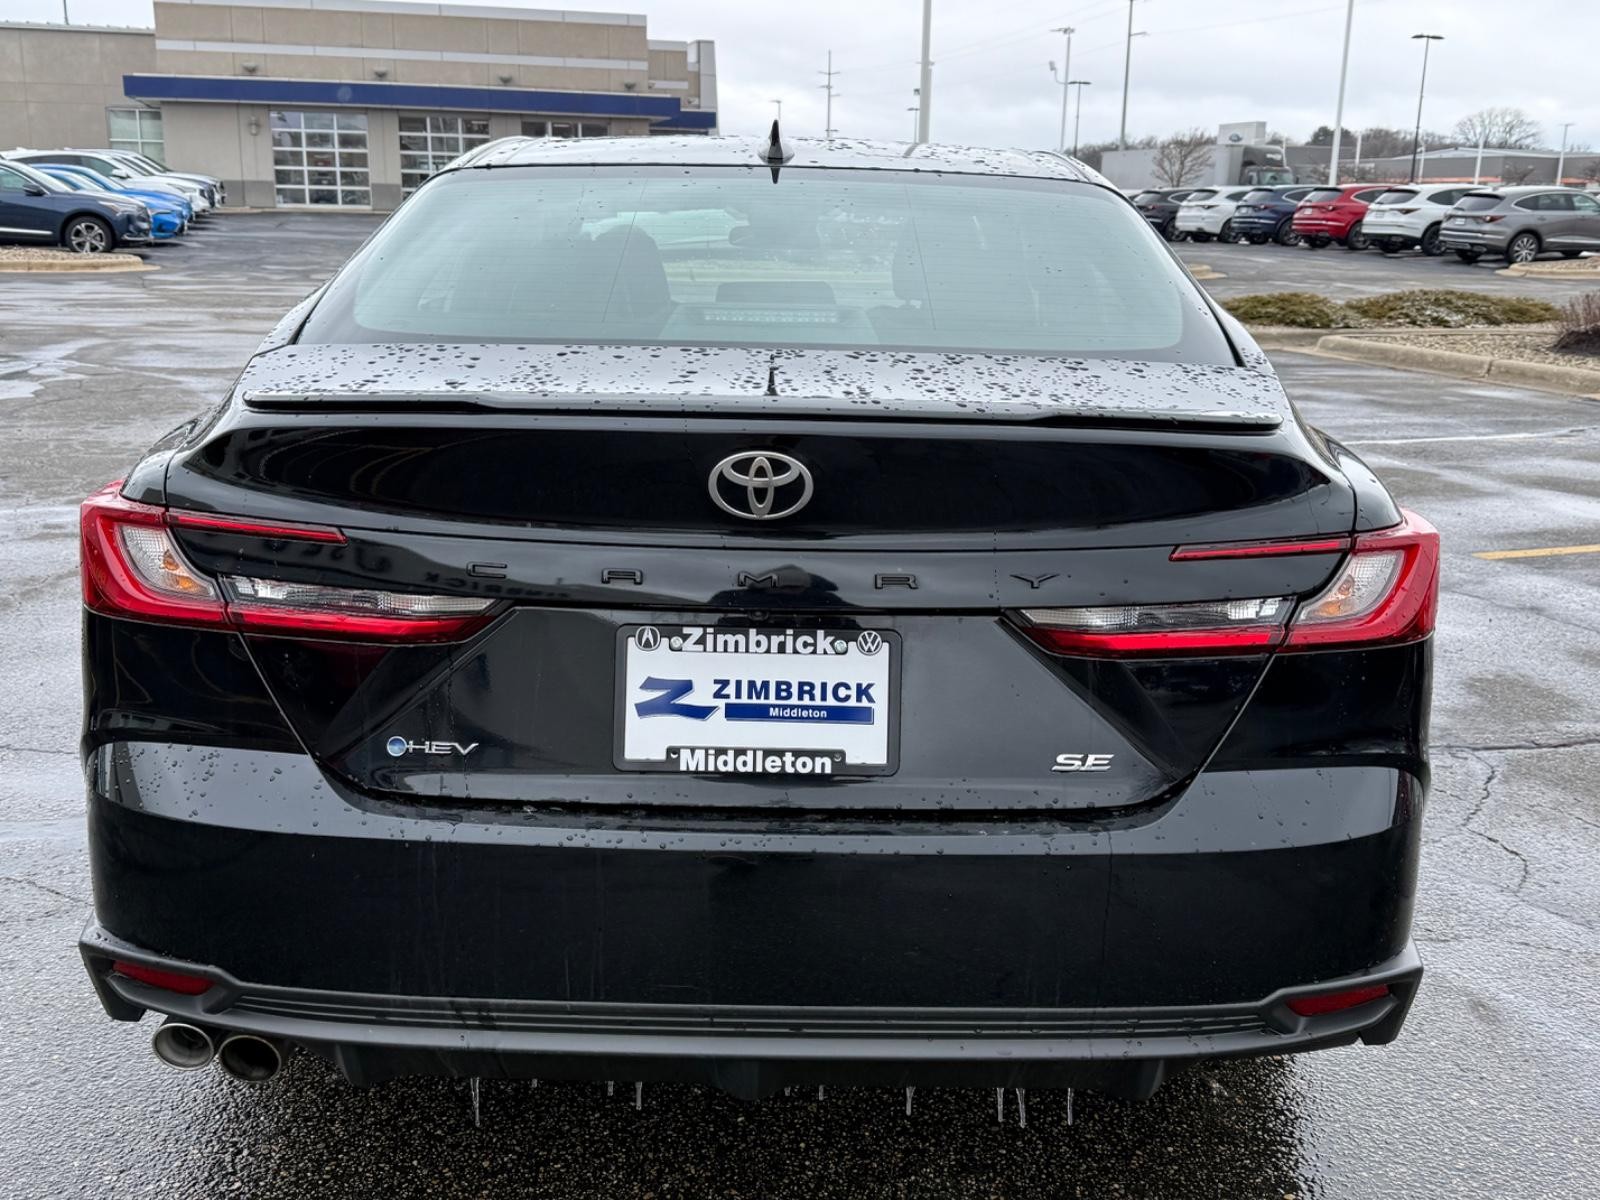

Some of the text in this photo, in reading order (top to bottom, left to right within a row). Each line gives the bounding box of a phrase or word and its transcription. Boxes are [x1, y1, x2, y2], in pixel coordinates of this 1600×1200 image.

[465, 561, 1061, 590] CAMRY
[682, 627, 837, 655] Zimbrick
[712, 679, 876, 704] ZIMBRICK
[769, 707, 827, 719] Middleton
[680, 748, 832, 774] Middleton
[1051, 753, 1115, 771] SE
